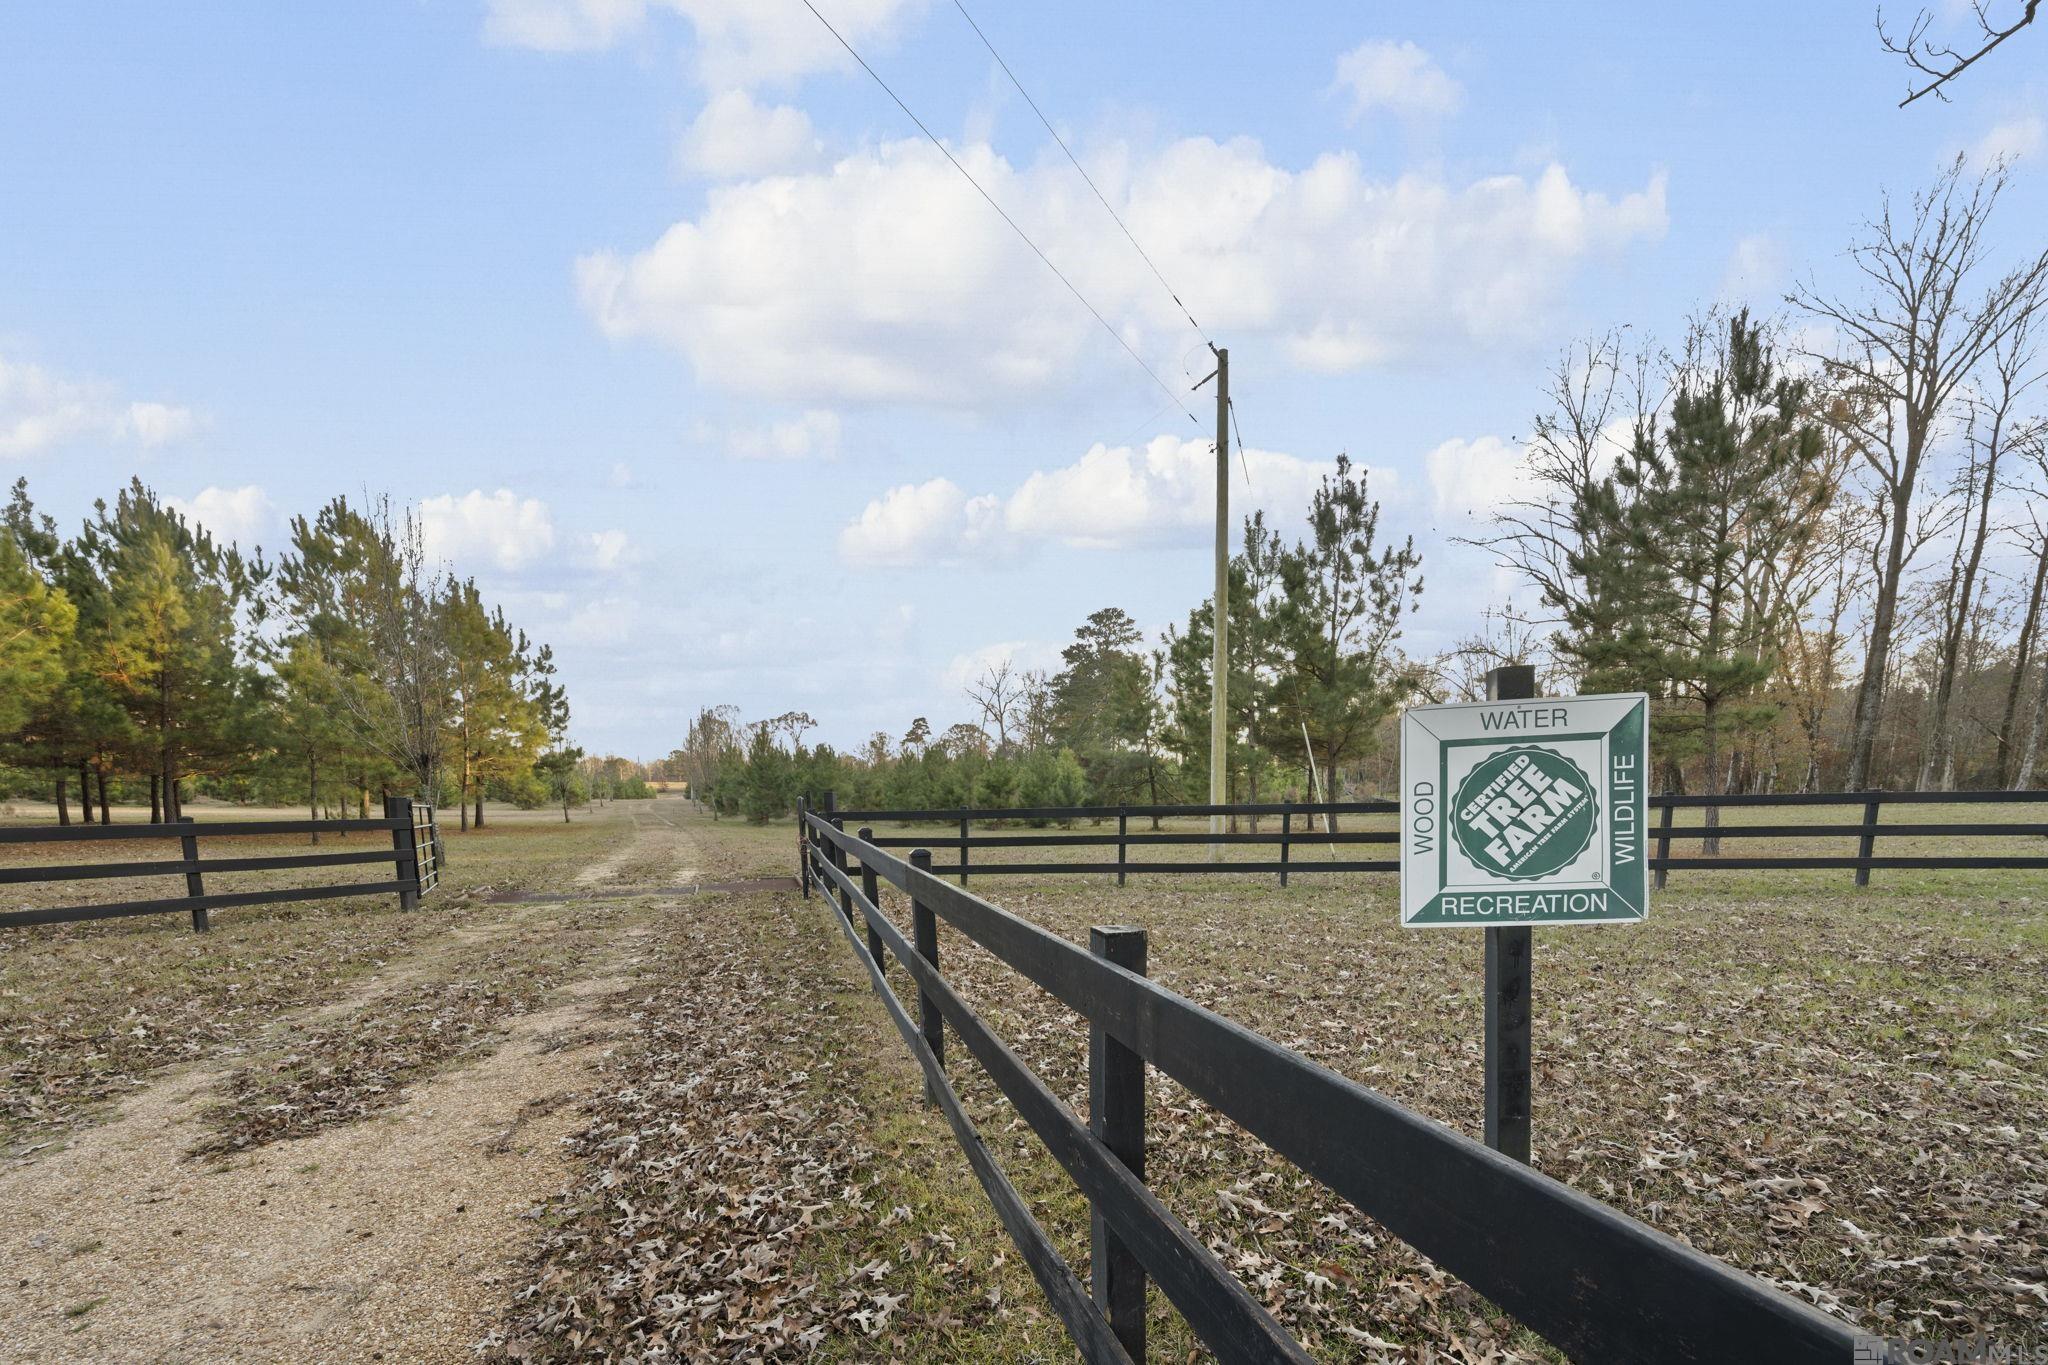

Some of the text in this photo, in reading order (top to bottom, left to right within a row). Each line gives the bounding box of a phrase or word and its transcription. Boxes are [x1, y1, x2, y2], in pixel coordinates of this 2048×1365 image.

[1480, 708, 1568, 730] WATER
[1413, 781, 1434, 856] WOOD
[1460, 754, 1530, 821] CERTIFIED
[1468, 763, 1553, 839] TREE
[1483, 777, 1584, 868] FARM
[1613, 753, 1636, 865] WILDLIFE
[1509, 844, 1539, 873] AMERICAN
[1537, 832, 1553, 846] TREE
[1550, 817, 1569, 834] FARM
[1441, 893, 1608, 916] RECREATION
